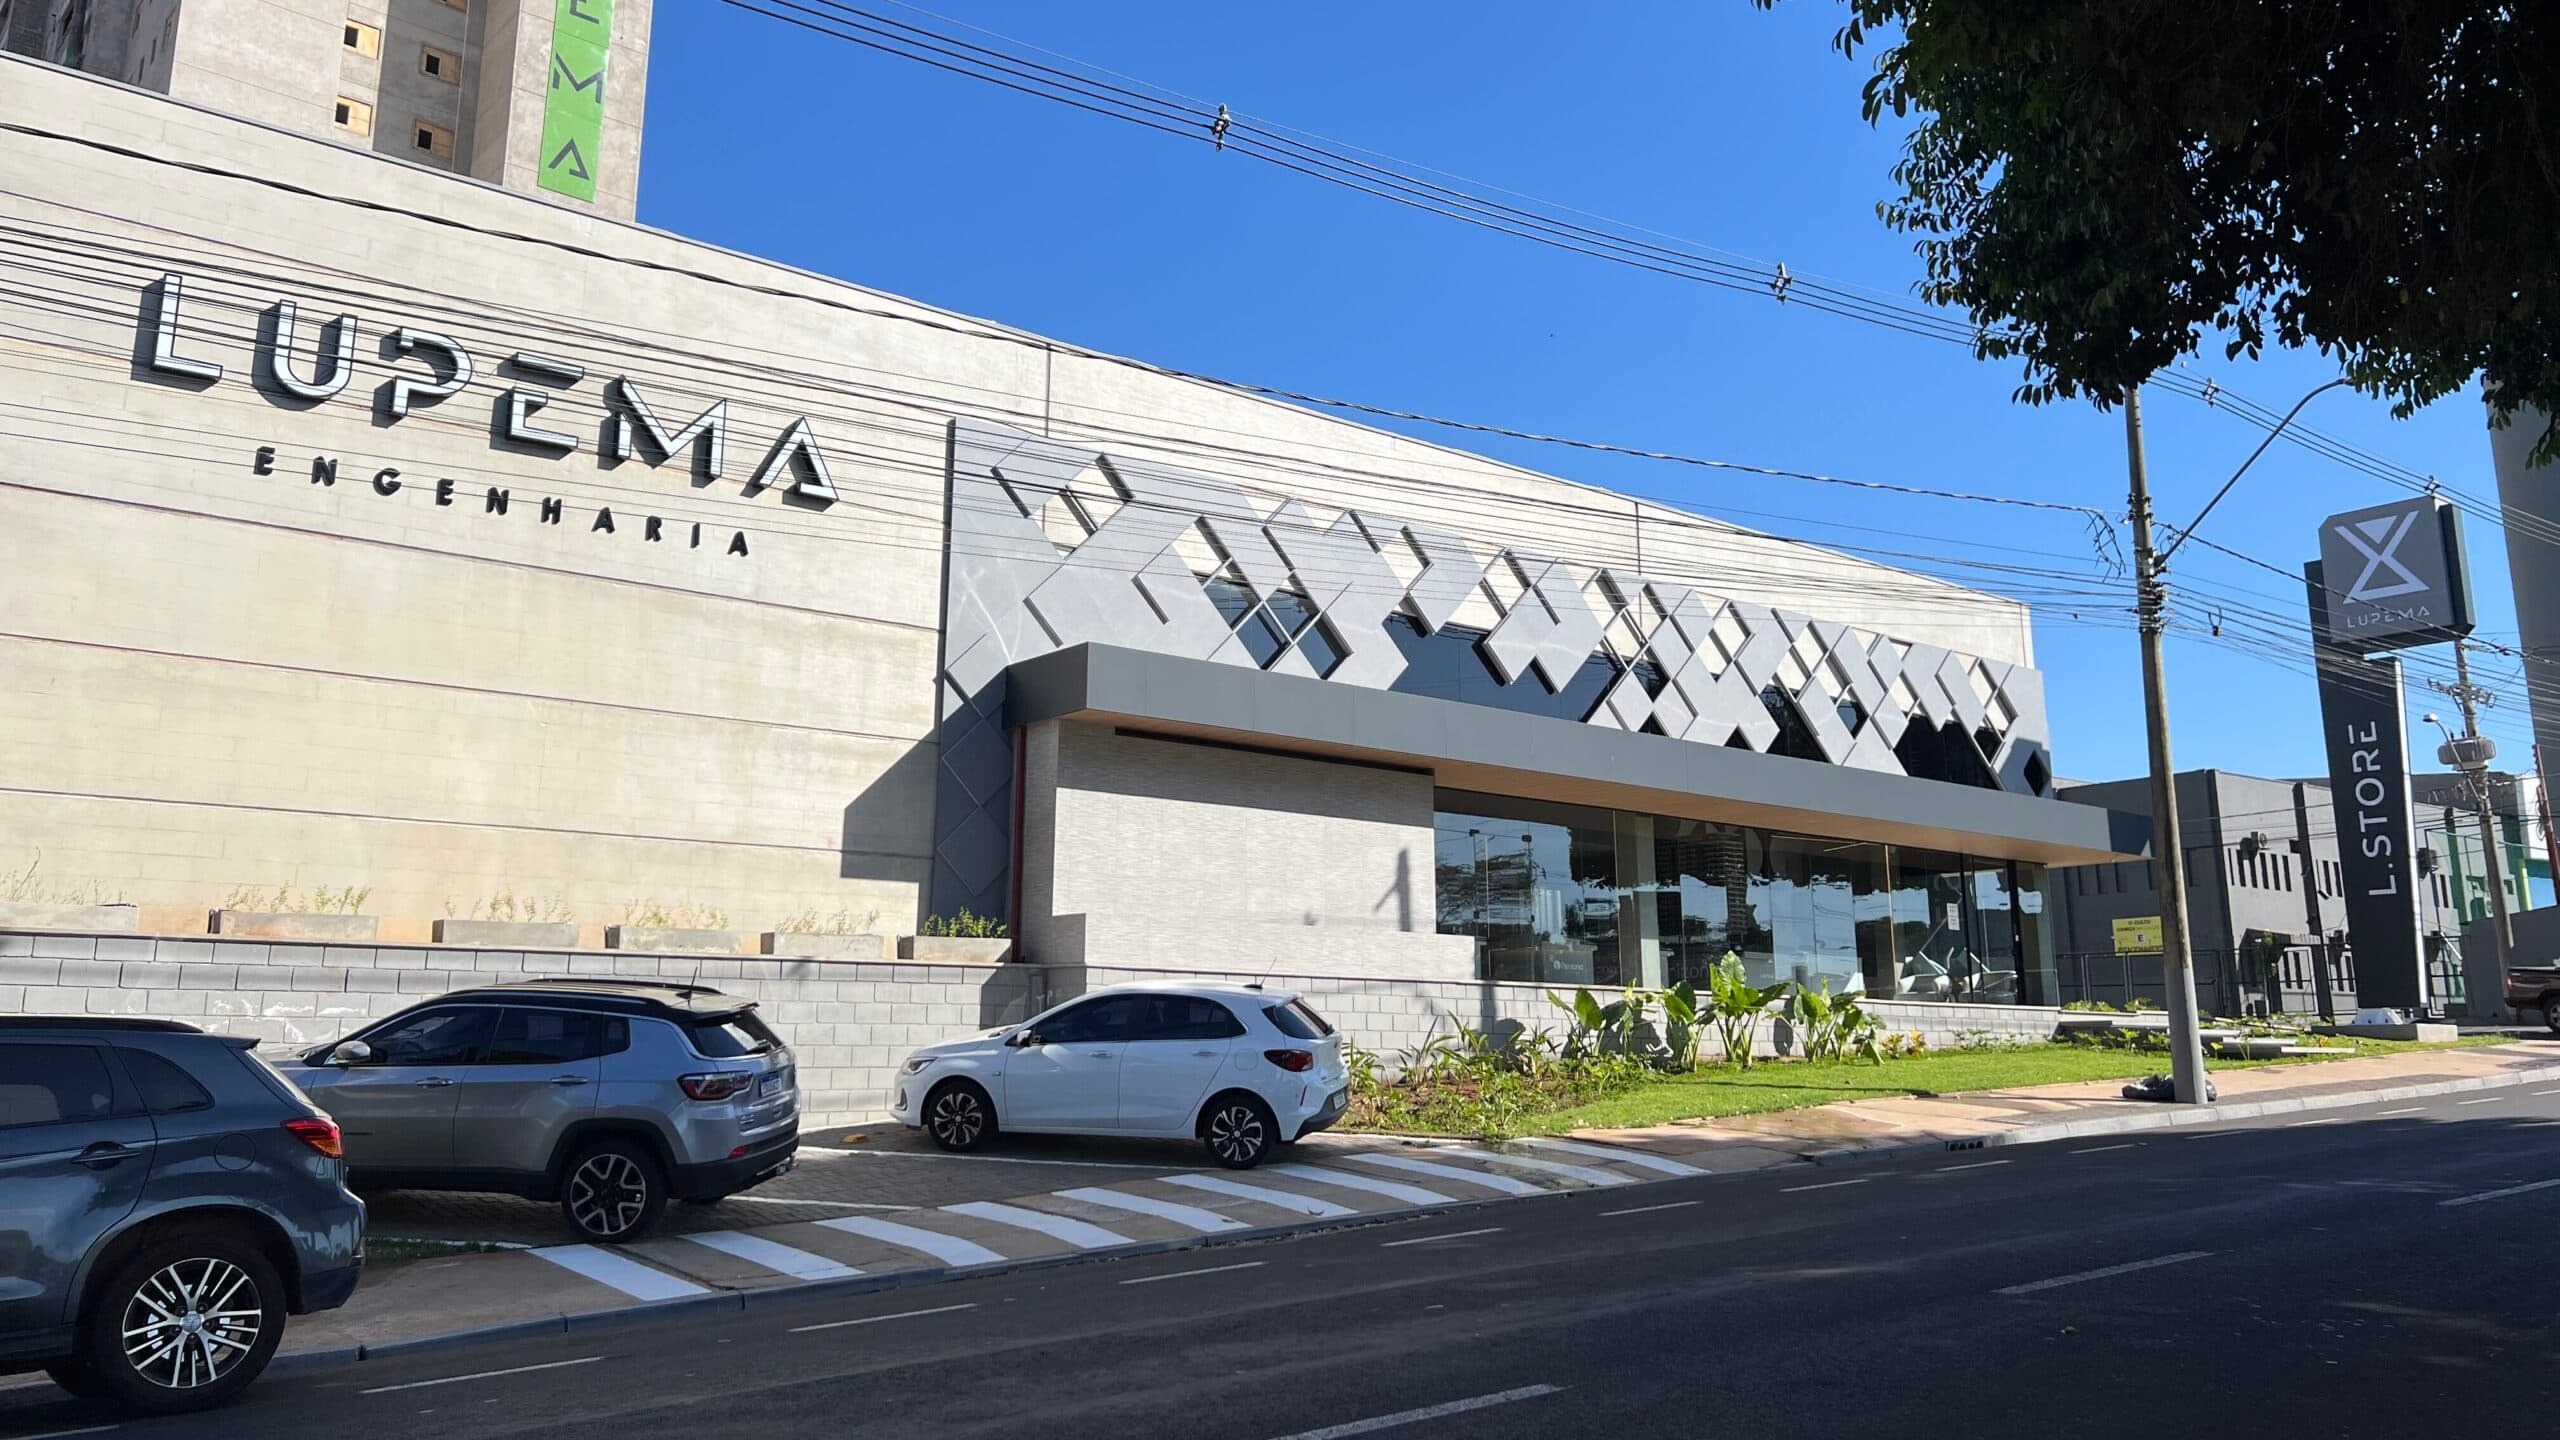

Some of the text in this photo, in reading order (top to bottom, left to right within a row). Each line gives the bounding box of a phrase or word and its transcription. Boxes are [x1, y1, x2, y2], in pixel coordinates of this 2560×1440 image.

[134, 273, 839, 510] LUPEMA
[254, 446, 749, 557] ENGENHARIA
[2346, 605, 2430, 628] LUPEMA
